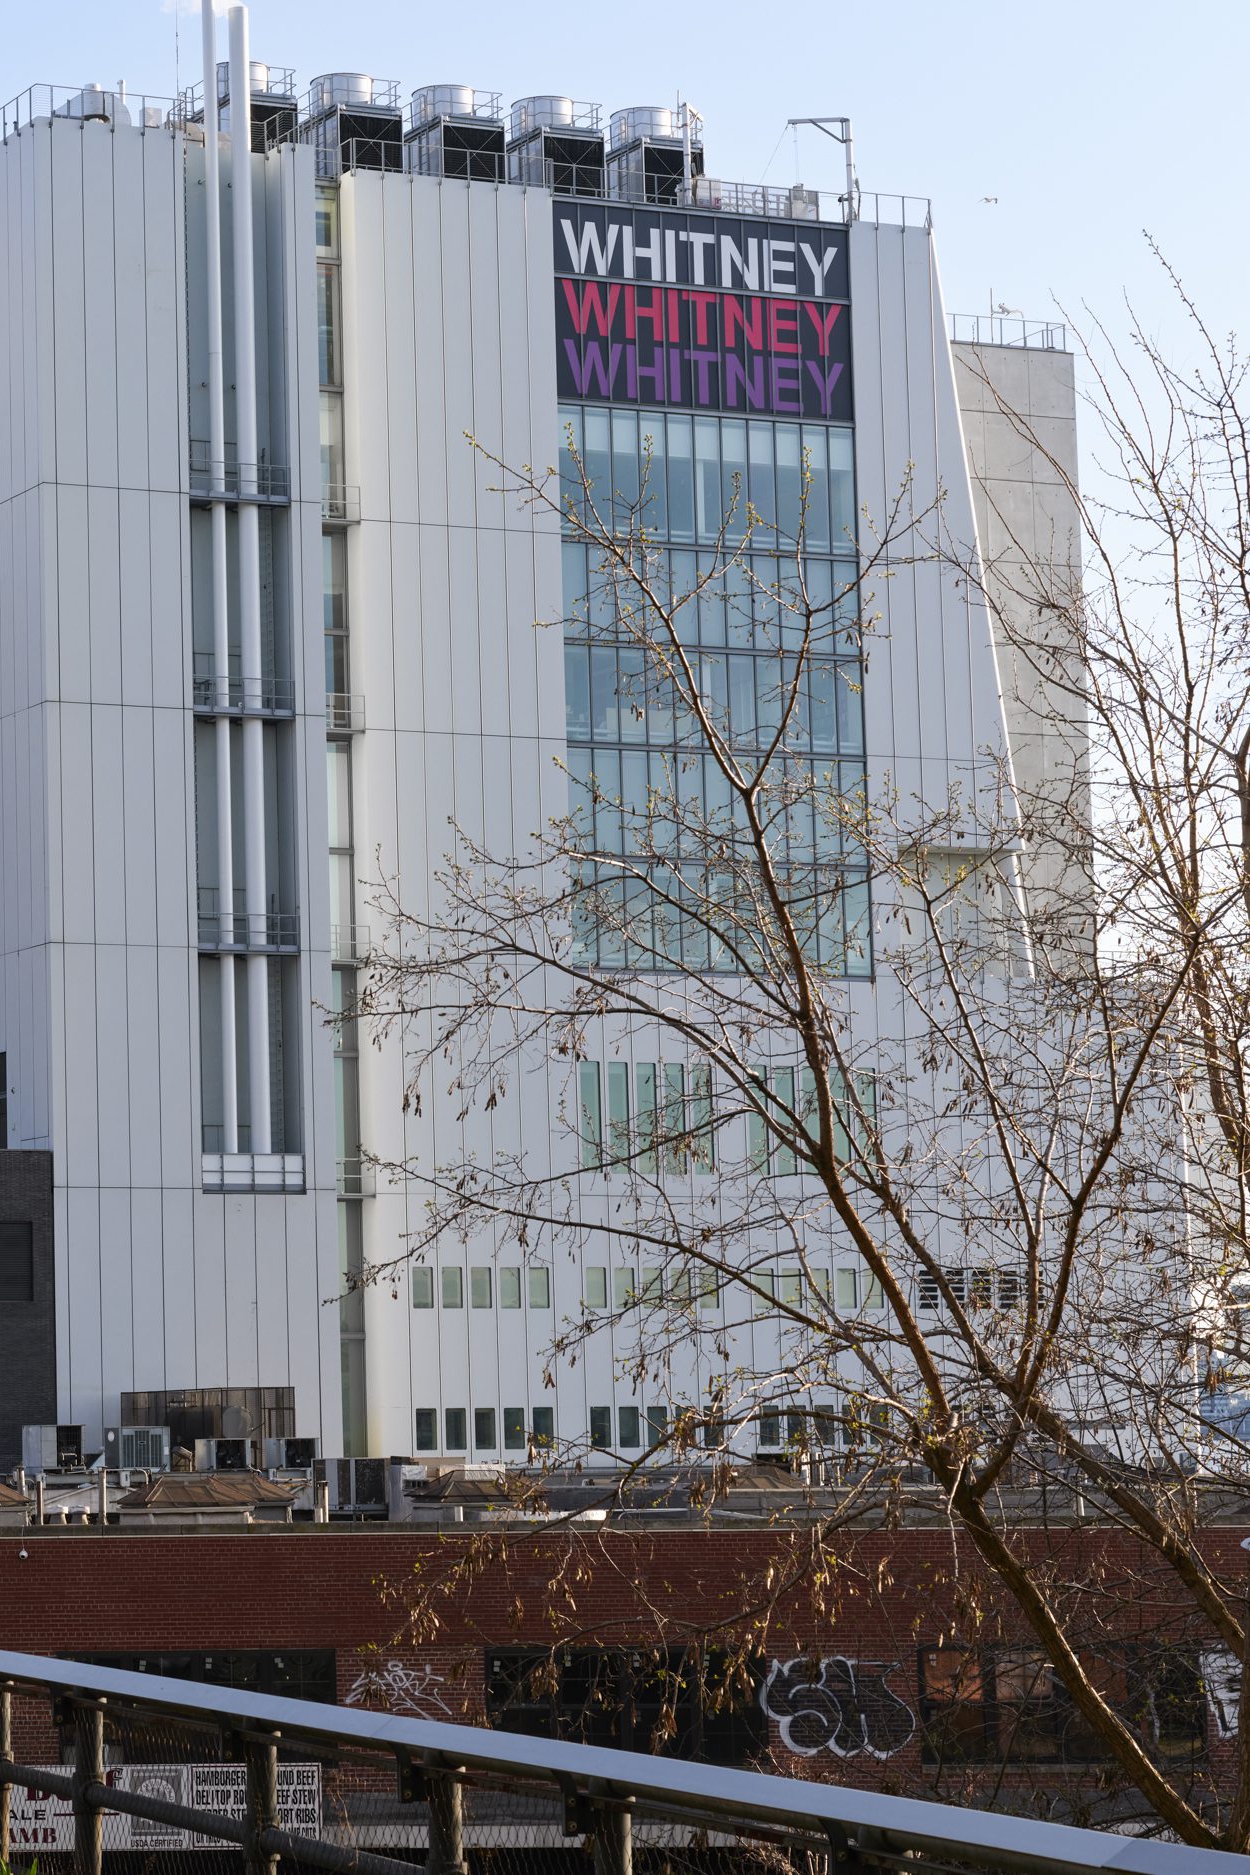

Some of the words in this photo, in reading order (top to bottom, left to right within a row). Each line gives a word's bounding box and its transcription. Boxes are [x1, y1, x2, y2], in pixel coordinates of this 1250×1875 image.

[560, 218, 838, 297] WHITNEY
[561, 278, 842, 357] WHITNEY
[563, 338, 845, 415] WHITNEY
[196, 1771, 246, 1786] HAMBURGER
[277, 1770, 294, 1786] UND
[297, 1770, 316, 1786] BEEF
[196, 1790, 214, 1805] DELI
[215, 1790, 230, 1805] TOP
[277, 1789, 291, 1804] EEF
[292, 1789, 316, 1805] STEW
[277, 1808, 293, 1824] ORT
[296, 1808, 316, 1824] RIBS
[130, 1839, 149, 1848] USDA
[150, 1839, 183, 1848] CERTIFIED
